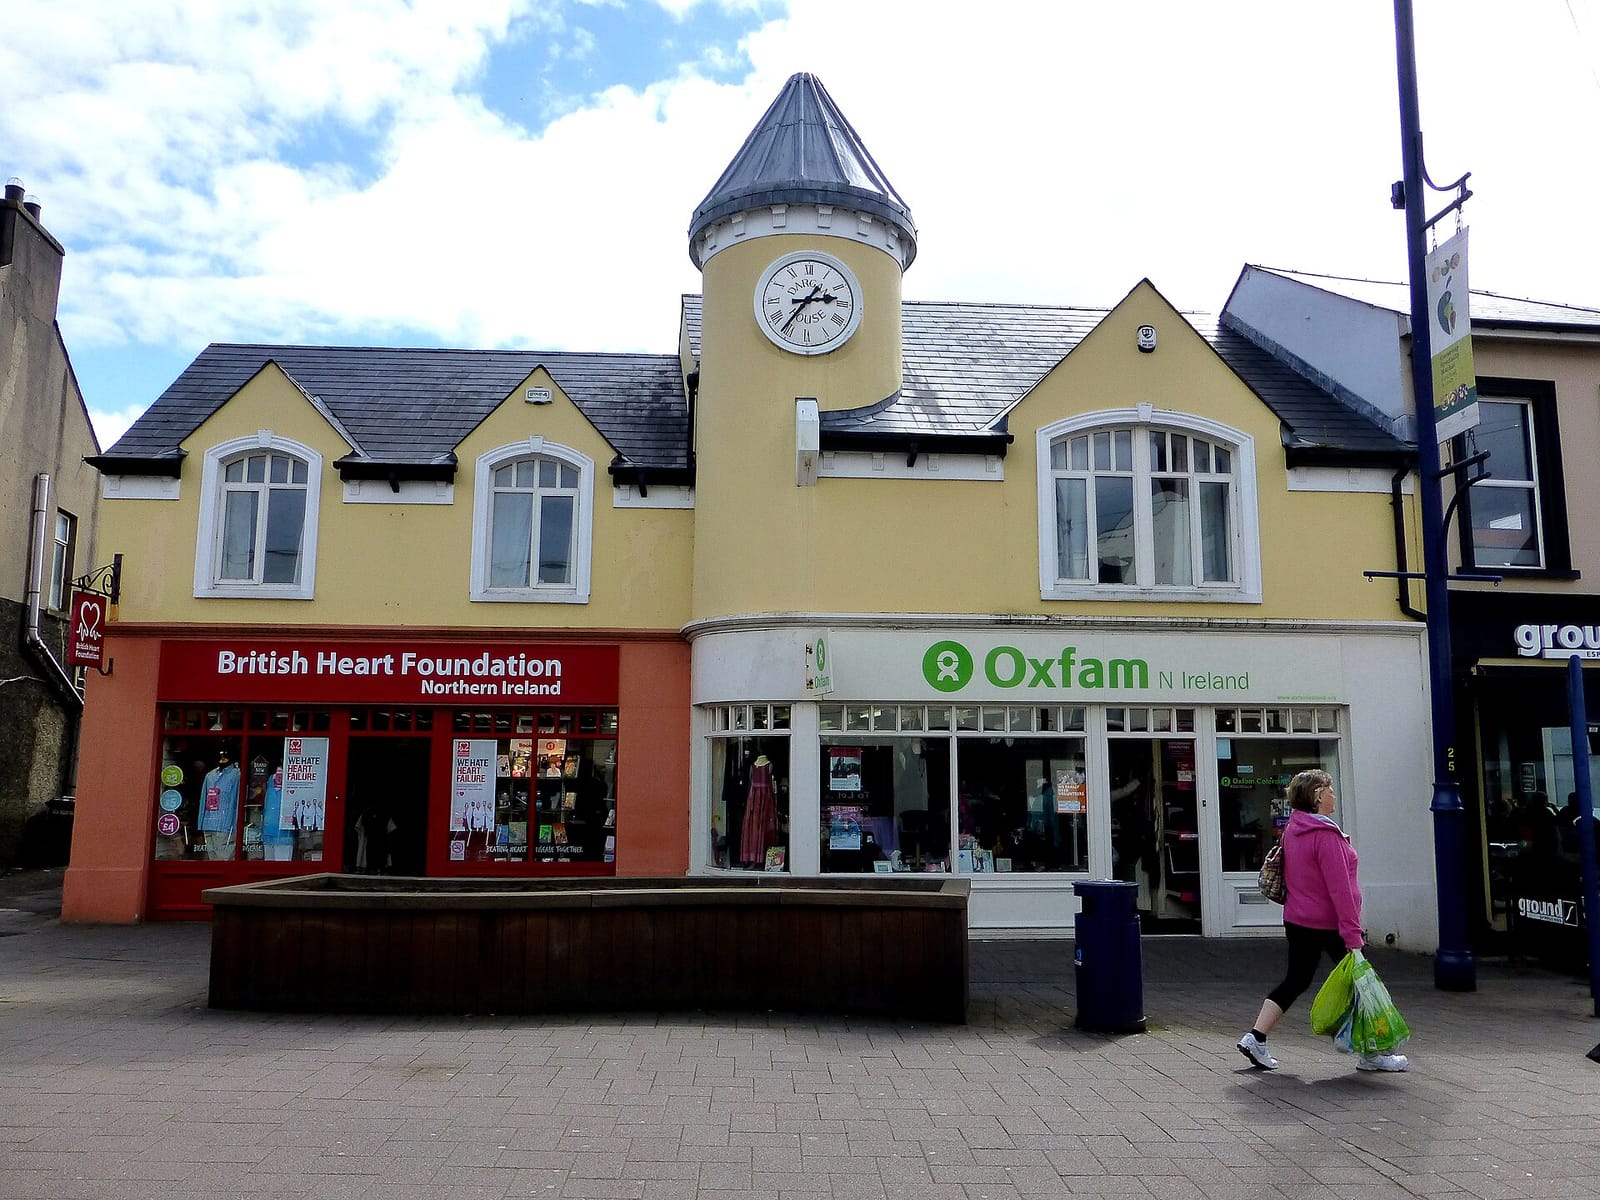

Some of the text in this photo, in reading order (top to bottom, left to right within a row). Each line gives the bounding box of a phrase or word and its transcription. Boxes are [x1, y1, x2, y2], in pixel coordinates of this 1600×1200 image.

[218, 650, 562, 677] British Heart Foundation
[984, 646, 1250, 690] Oxfam N Ireland
[421, 679, 561, 695] Northern Ireland
[288, 757, 320, 765] WE HATE
[457, 759, 489, 767] WE HATE
[287, 764, 313, 773] HEART
[457, 767, 481, 775] HEART
[287, 772, 317, 781] FAILURE
[1518, 897, 1563, 918] ground
